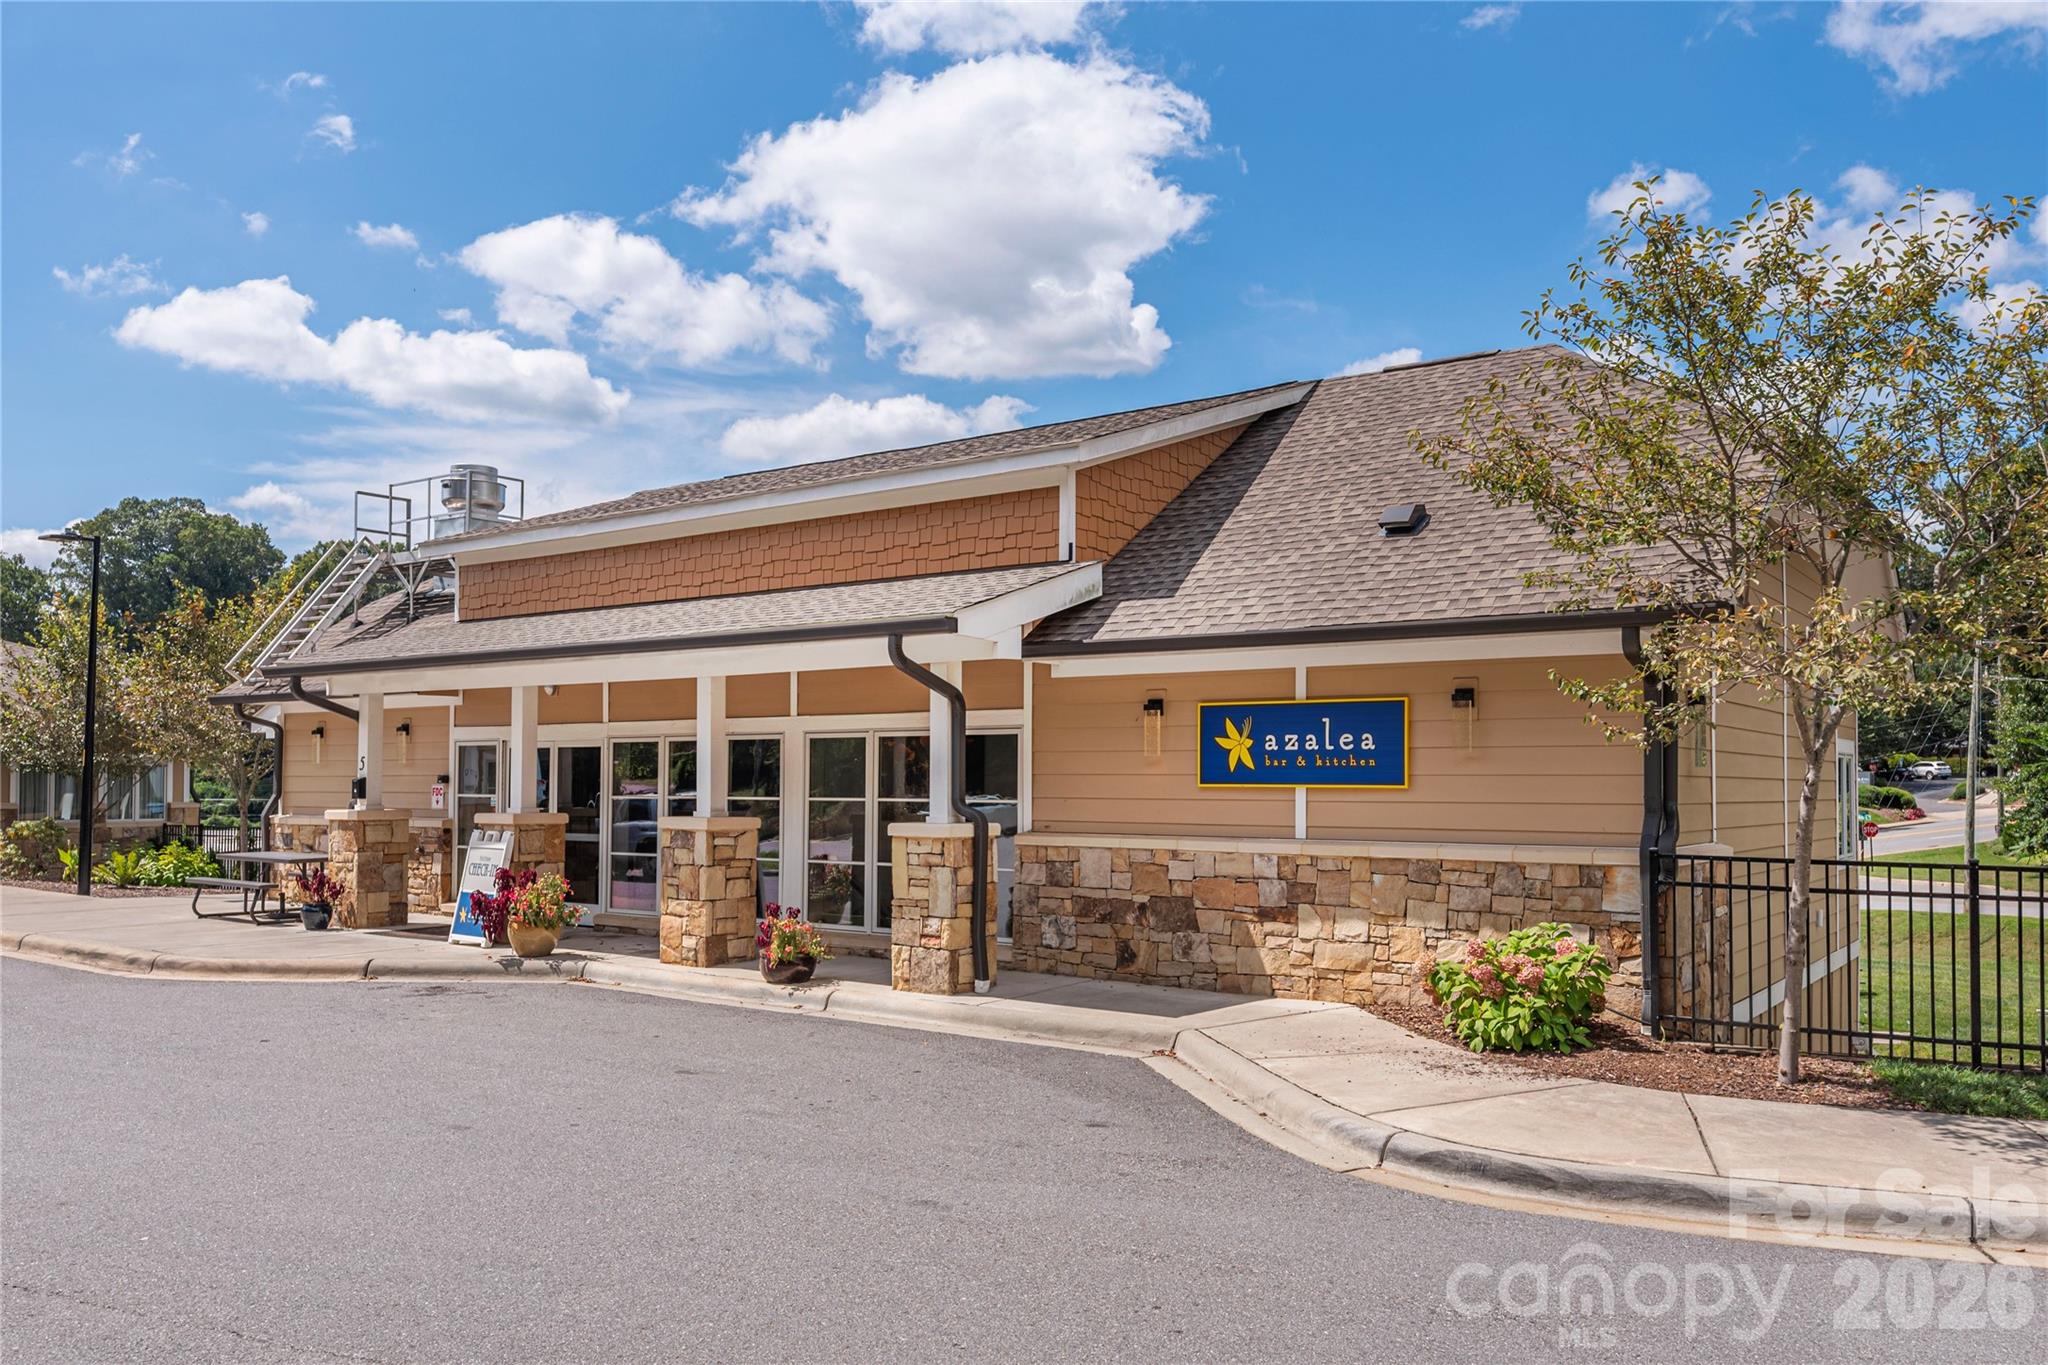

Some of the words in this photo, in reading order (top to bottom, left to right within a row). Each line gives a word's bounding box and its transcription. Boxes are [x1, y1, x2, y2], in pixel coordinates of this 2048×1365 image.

[1264, 717, 1376, 751] azalea
[359, 756, 366, 771] 5
[1264, 755, 1287, 767] bar
[1296, 756, 1306, 767] &
[1315, 754, 1376, 767] kitchen
[432, 787, 443, 797] FDC
